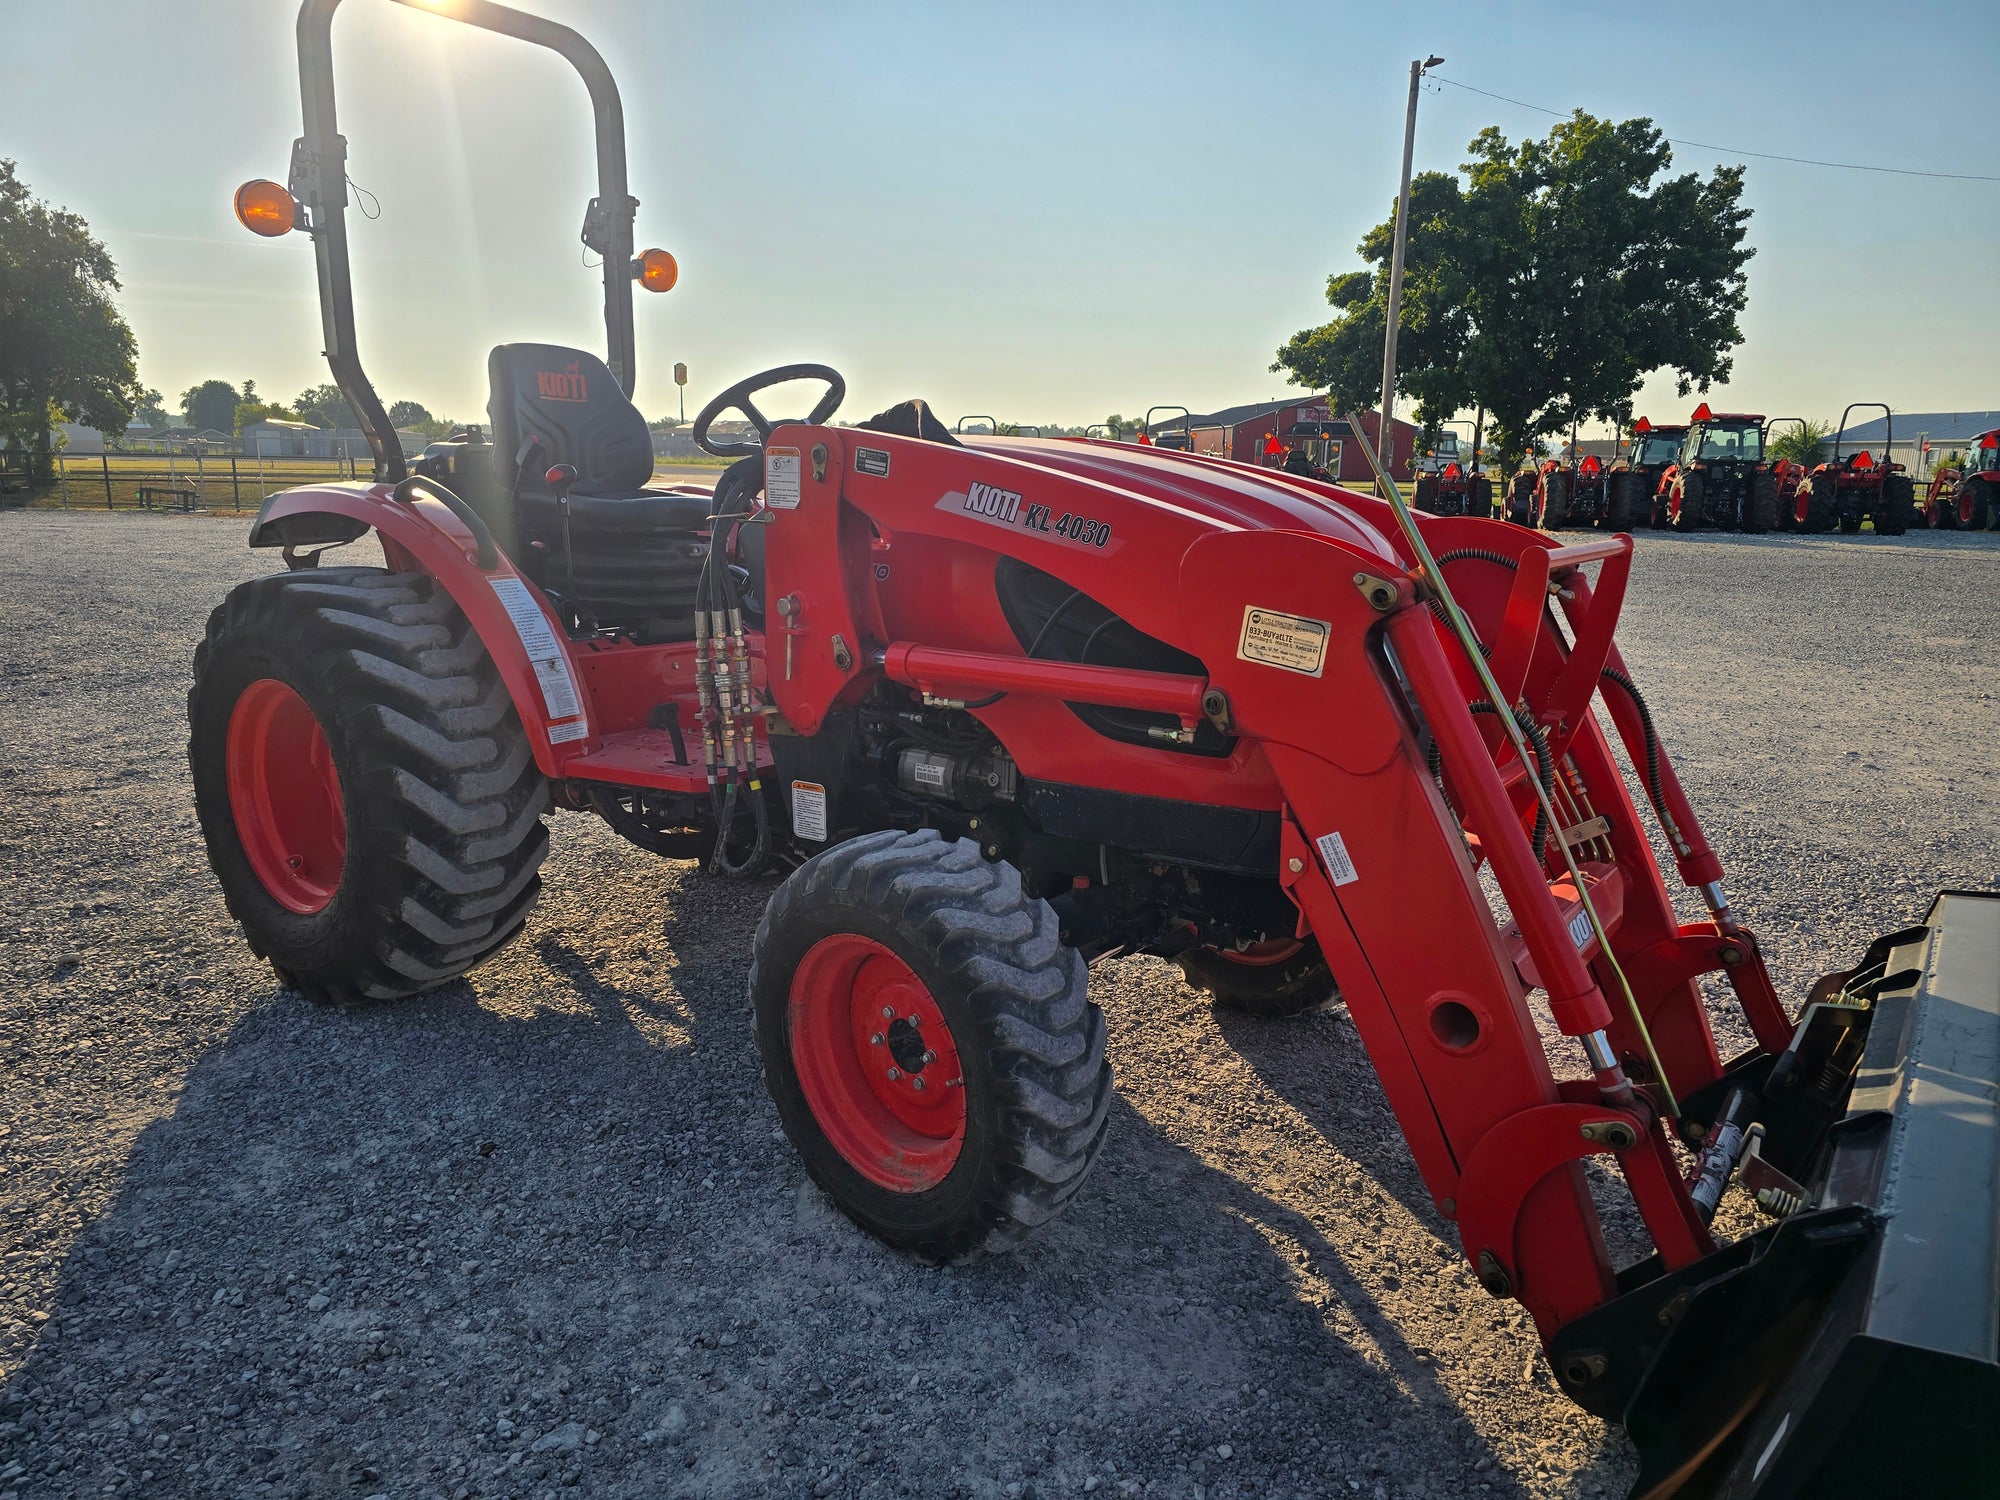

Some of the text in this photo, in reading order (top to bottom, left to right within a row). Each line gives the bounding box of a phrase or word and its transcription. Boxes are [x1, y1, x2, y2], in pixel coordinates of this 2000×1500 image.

[537, 370, 587, 399] KIOTI
[964, 481, 1112, 549] KIOTI KL 4030
[1568, 908, 1594, 949] KIOT
